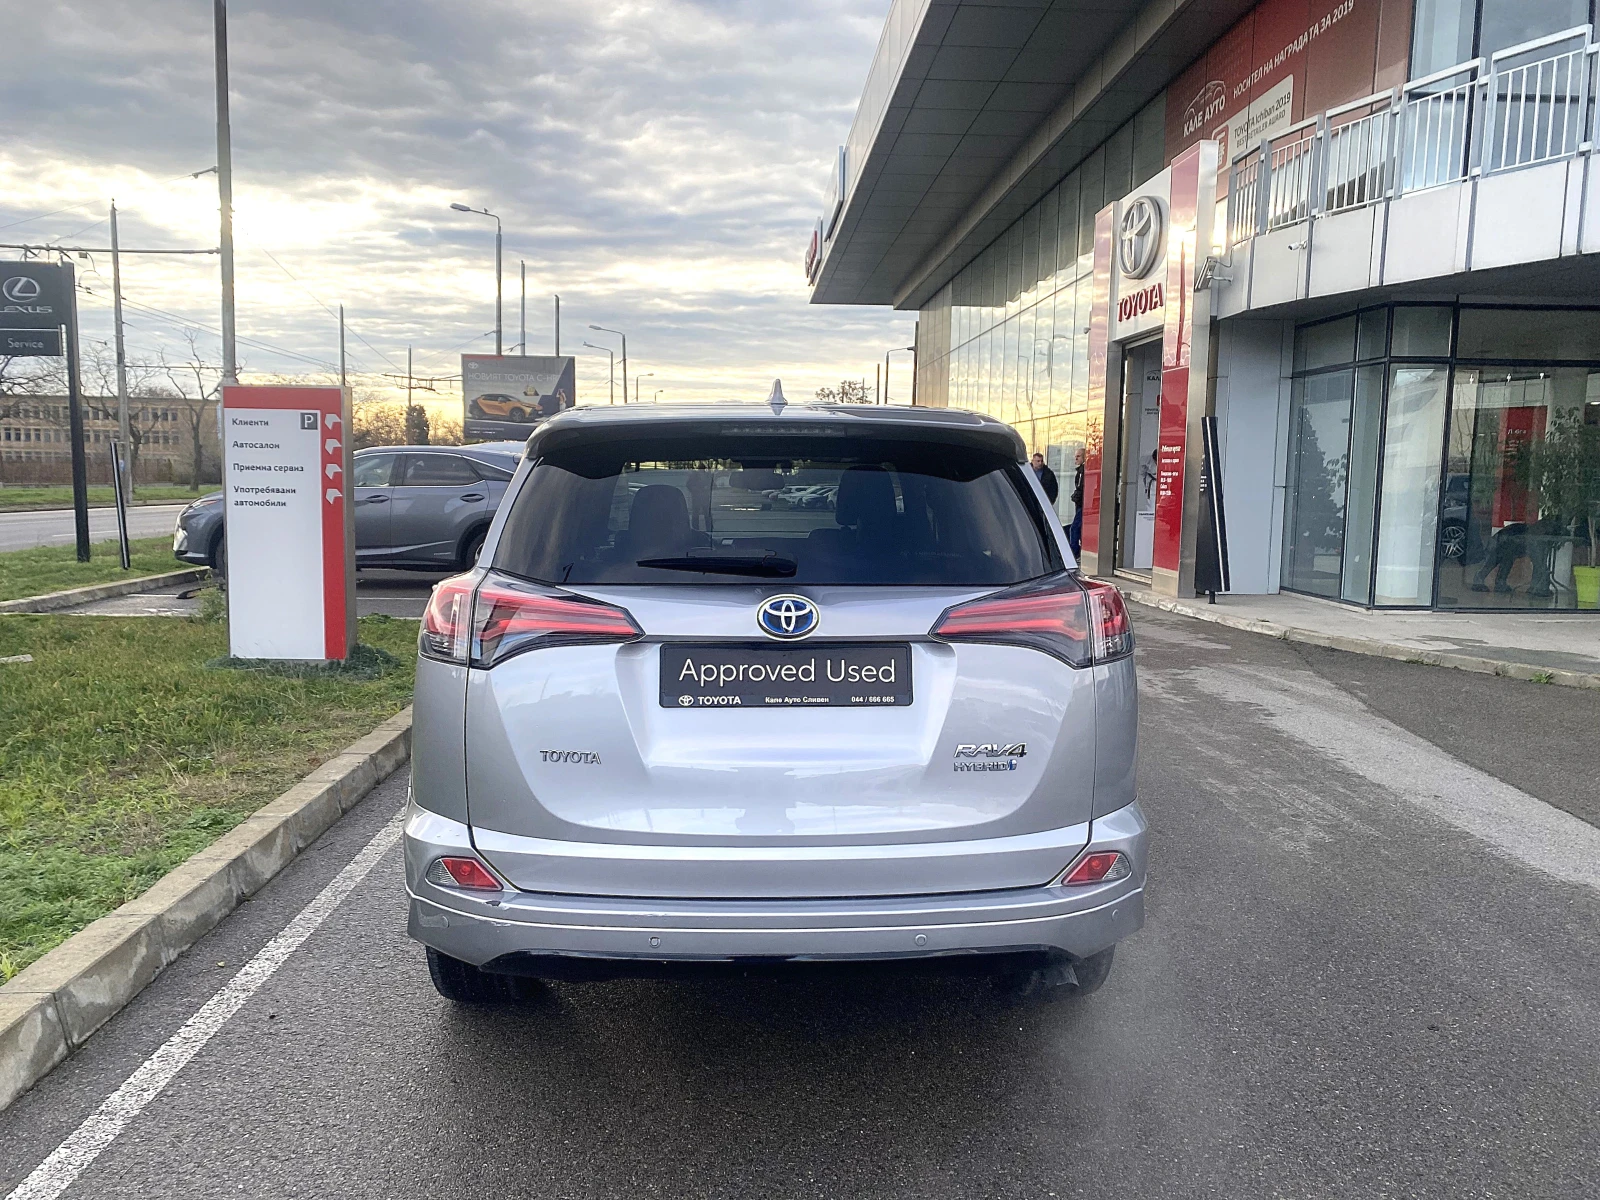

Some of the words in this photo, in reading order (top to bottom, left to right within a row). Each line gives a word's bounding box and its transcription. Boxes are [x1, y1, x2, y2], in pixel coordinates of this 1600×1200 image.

[1263, 58, 1274, 75] НА
[1320, 13, 1331, 32] ЗА
[1332, 0, 1354, 23] 2019
[1183, 110, 1204, 138] КАЛЕ
[1204, 95, 1226, 122] АУТО
[1234, 116, 1255, 139] TOYOTA
[1275, 91, 1291, 111] 2019
[1117, 282, 1164, 322] TOYOTA
[7, 337, 44, 348] Service
[467, 372, 501, 381] НОВИЯТ
[504, 373, 534, 382] TOYOTA
[231, 418, 269, 426] Клиенти
[232, 440, 280, 449] Автосалон
[233, 463, 272, 472] Приемна
[273, 465, 304, 473] сервиз
[233, 485, 296, 495] Употребявани
[234, 499, 287, 507] автомобили
[679, 658, 815, 687] Approved
[826, 658, 896, 683] Used
[697, 696, 742, 705] TOYOTA
[784, 696, 801, 704] Ауто
[953, 742, 1028, 758] RAV4
[539, 750, 602, 765] TOYOTA
[953, 761, 1009, 771] HYBRID
